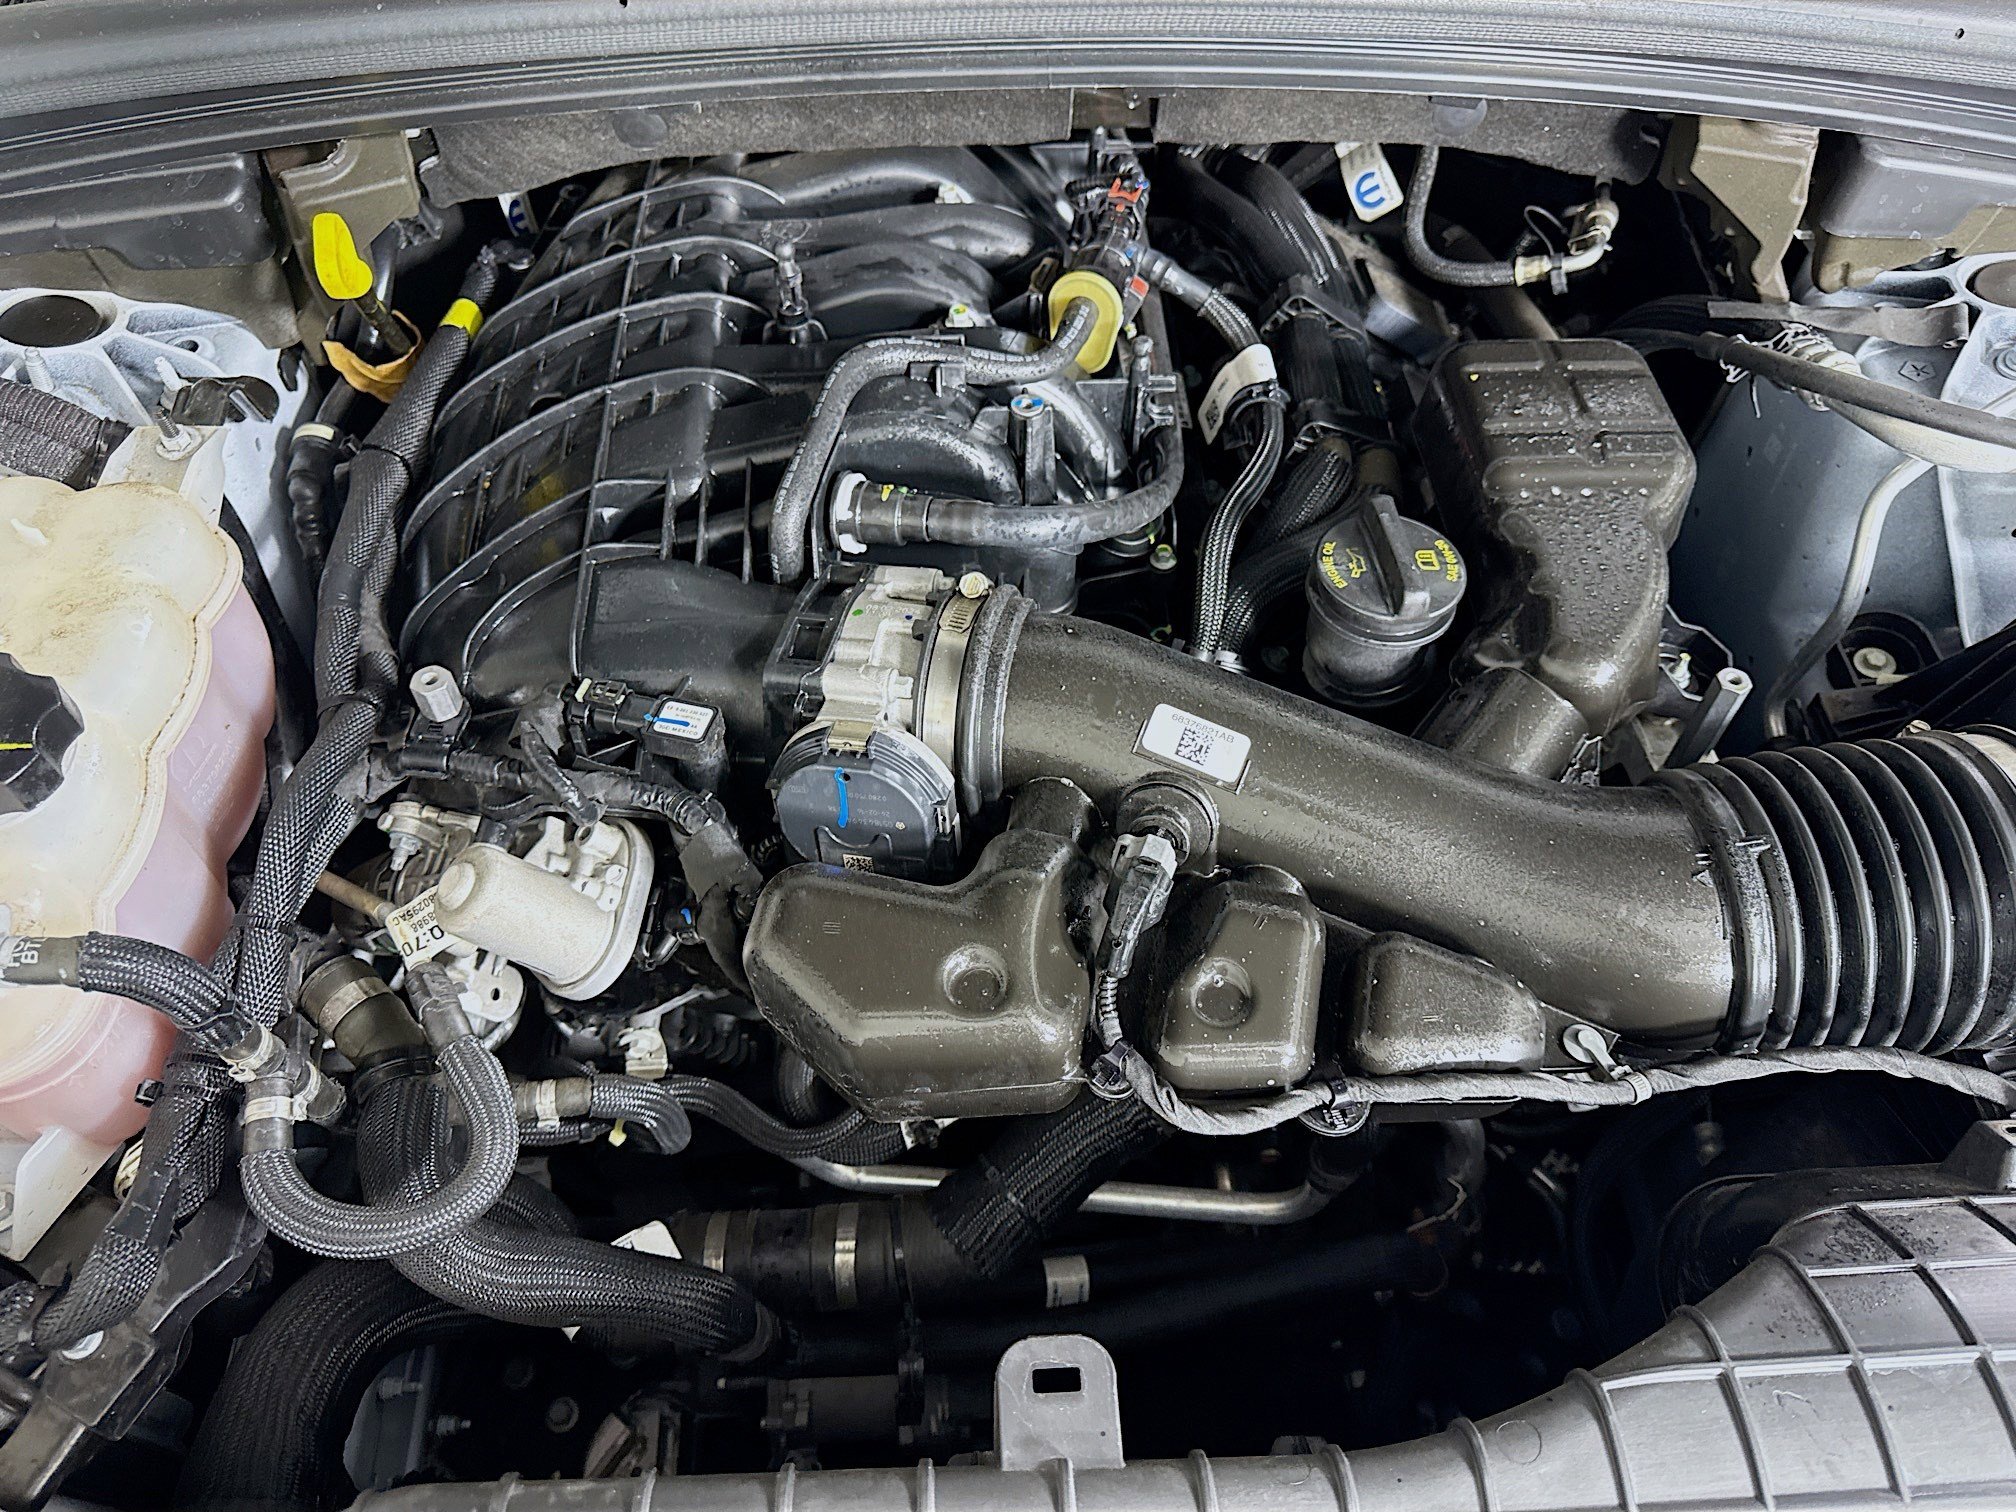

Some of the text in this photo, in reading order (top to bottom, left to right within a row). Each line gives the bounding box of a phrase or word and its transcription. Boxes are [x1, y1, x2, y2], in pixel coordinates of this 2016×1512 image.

[1322, 542, 1348, 589] ENGINE OIL
[1446, 564, 1459, 581] SAE
[1171, 713, 1234, 743] 68376821AB
[392, 893, 437, 925] 80295AC
[411, 912, 437, 932] 8988
